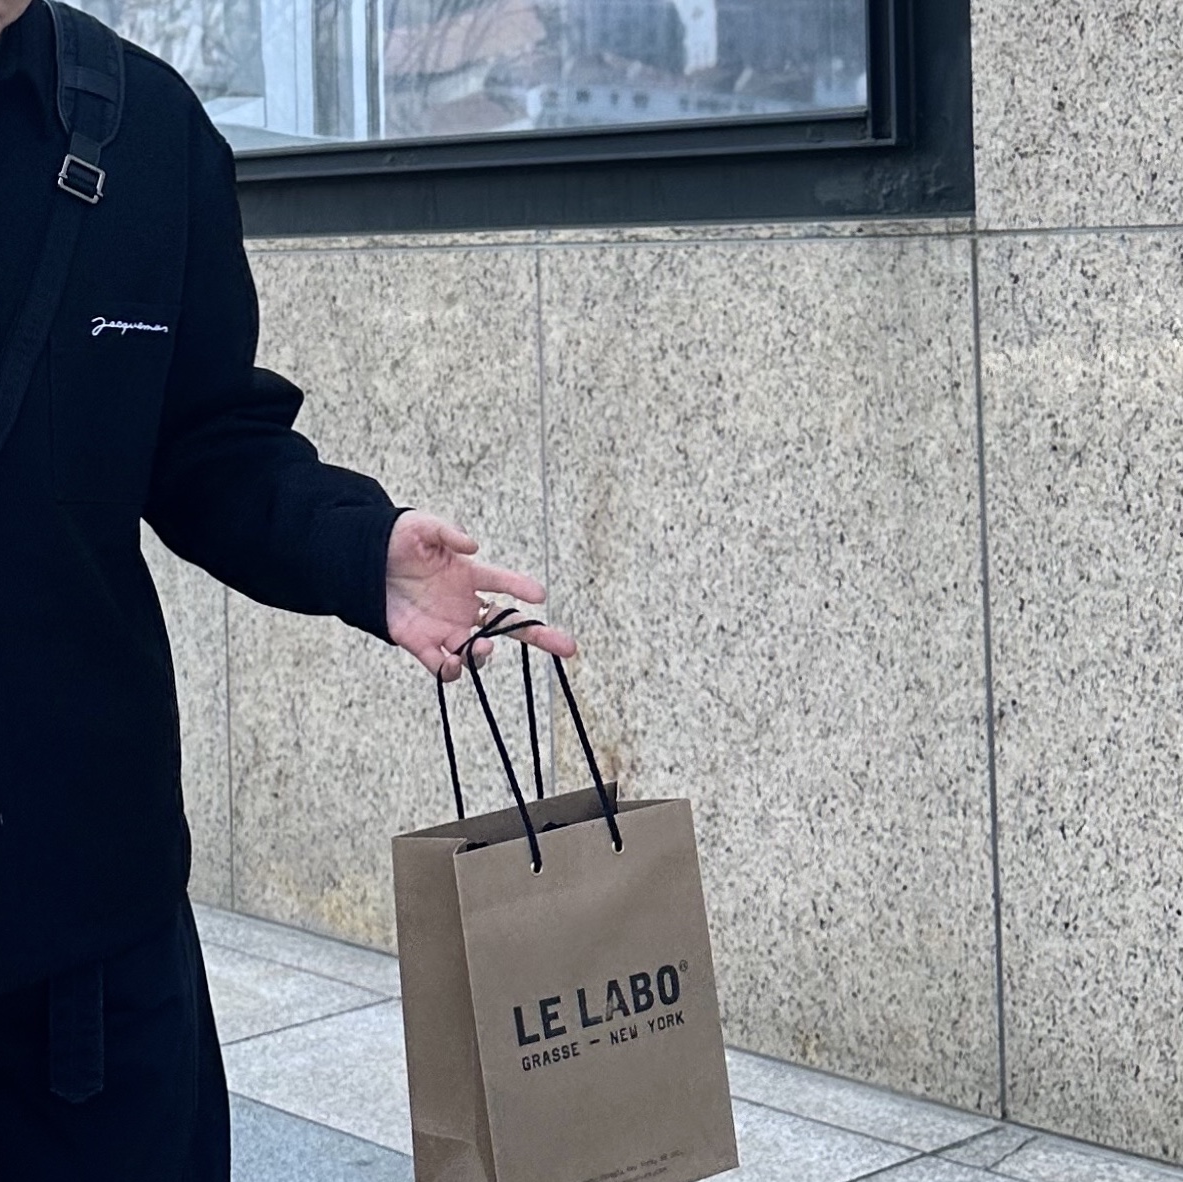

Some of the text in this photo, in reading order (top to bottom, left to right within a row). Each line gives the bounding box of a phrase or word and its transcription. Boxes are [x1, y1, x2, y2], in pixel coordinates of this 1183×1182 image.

[513, 996, 567, 1046] LE
[522, 1042, 580, 1071] GRASSE
[610, 1024, 638, 1045] NEW
[647, 1010, 685, 1033] YORK
